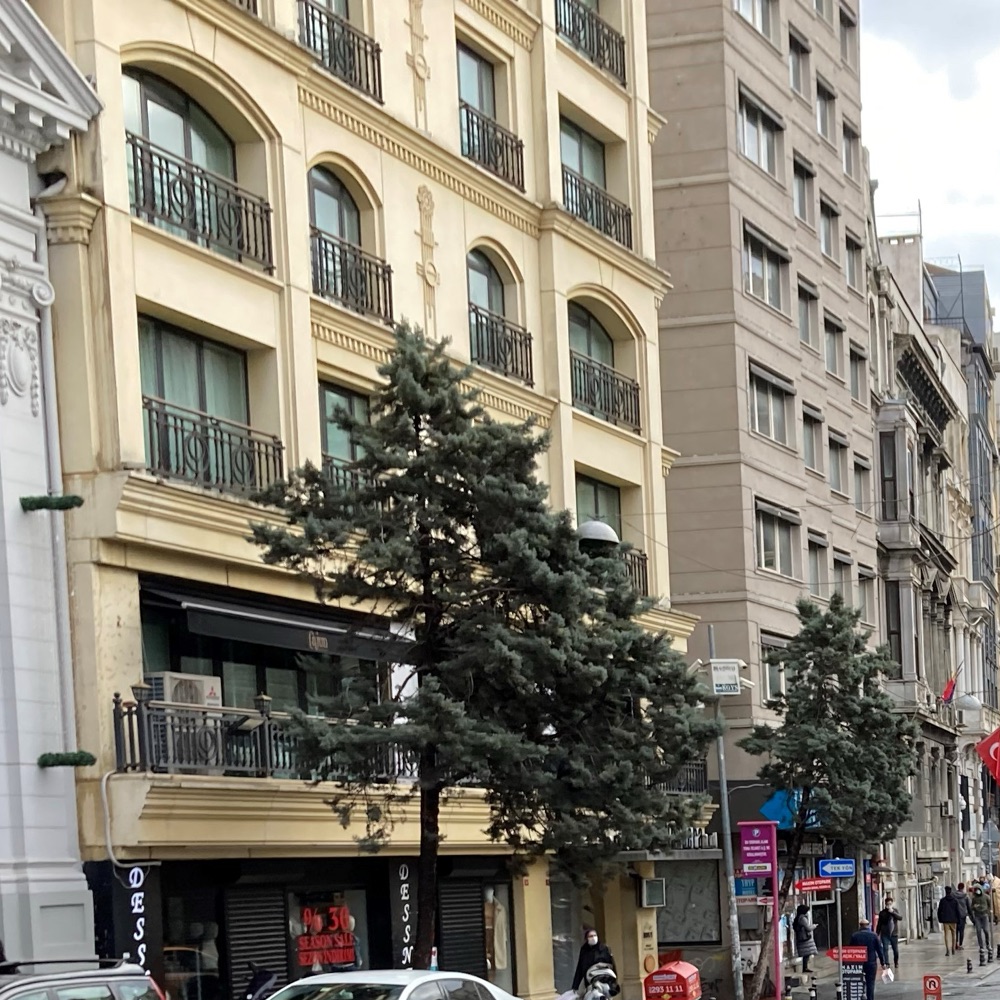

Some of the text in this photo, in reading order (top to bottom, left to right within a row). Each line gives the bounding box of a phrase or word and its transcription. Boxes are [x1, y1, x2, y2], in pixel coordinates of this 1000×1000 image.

[129, 866, 147, 967] DESS
[328, 906, 350, 931] 30
[398, 863, 414, 970] DESSN
